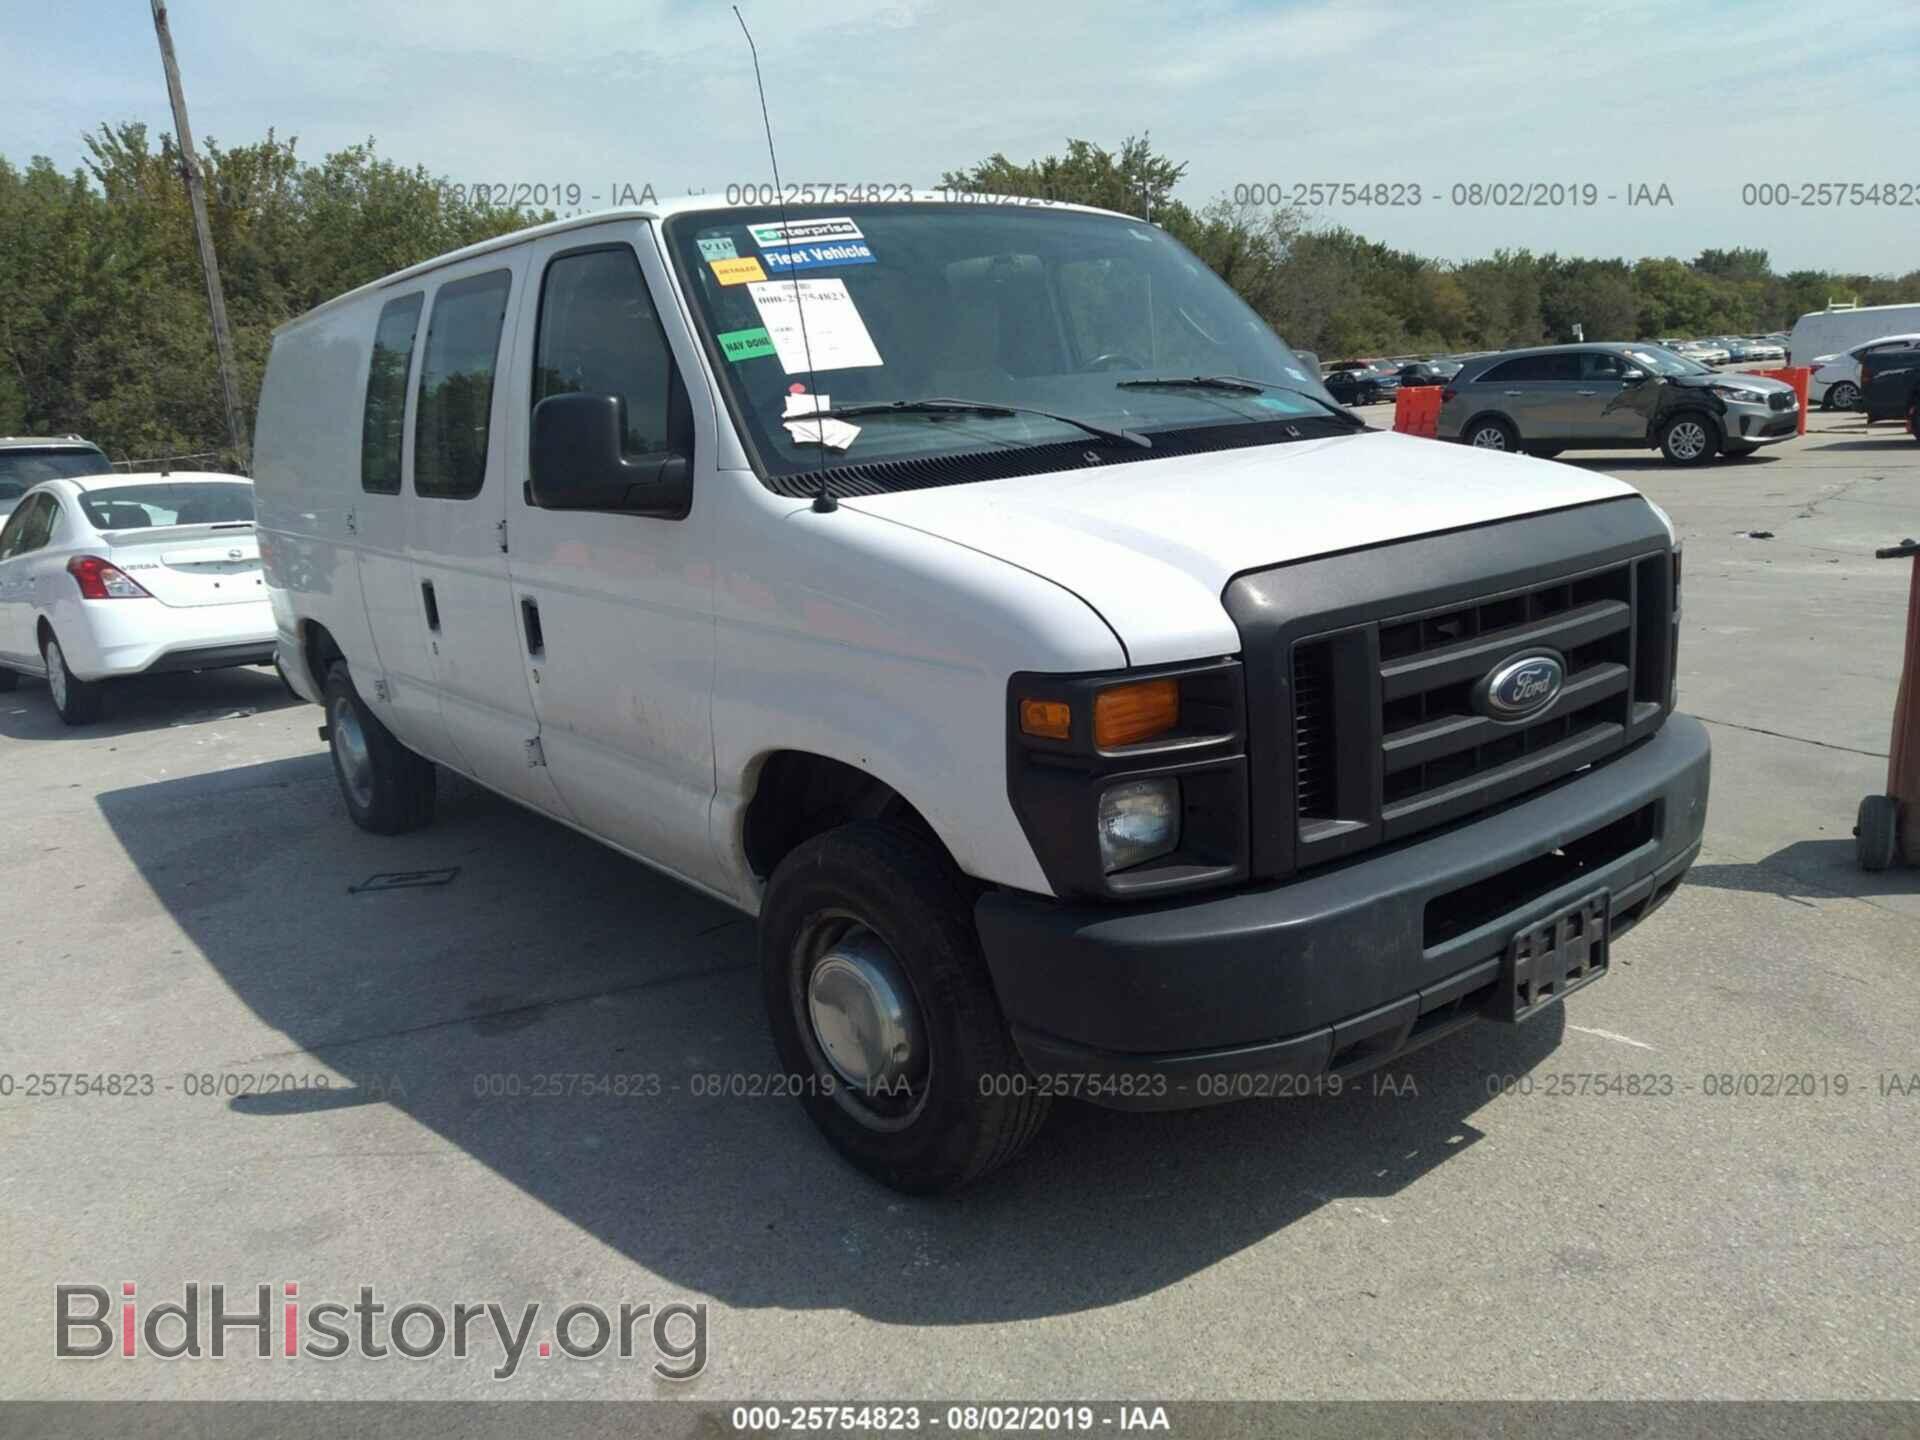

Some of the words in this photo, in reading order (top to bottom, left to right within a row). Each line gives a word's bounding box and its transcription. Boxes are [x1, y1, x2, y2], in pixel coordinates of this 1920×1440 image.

[764, 223, 855, 240] enterprise
[764, 250, 811, 266] Fleet
[810, 244, 872, 261] Vehicle
[1513, 667, 1552, 701] Ford
